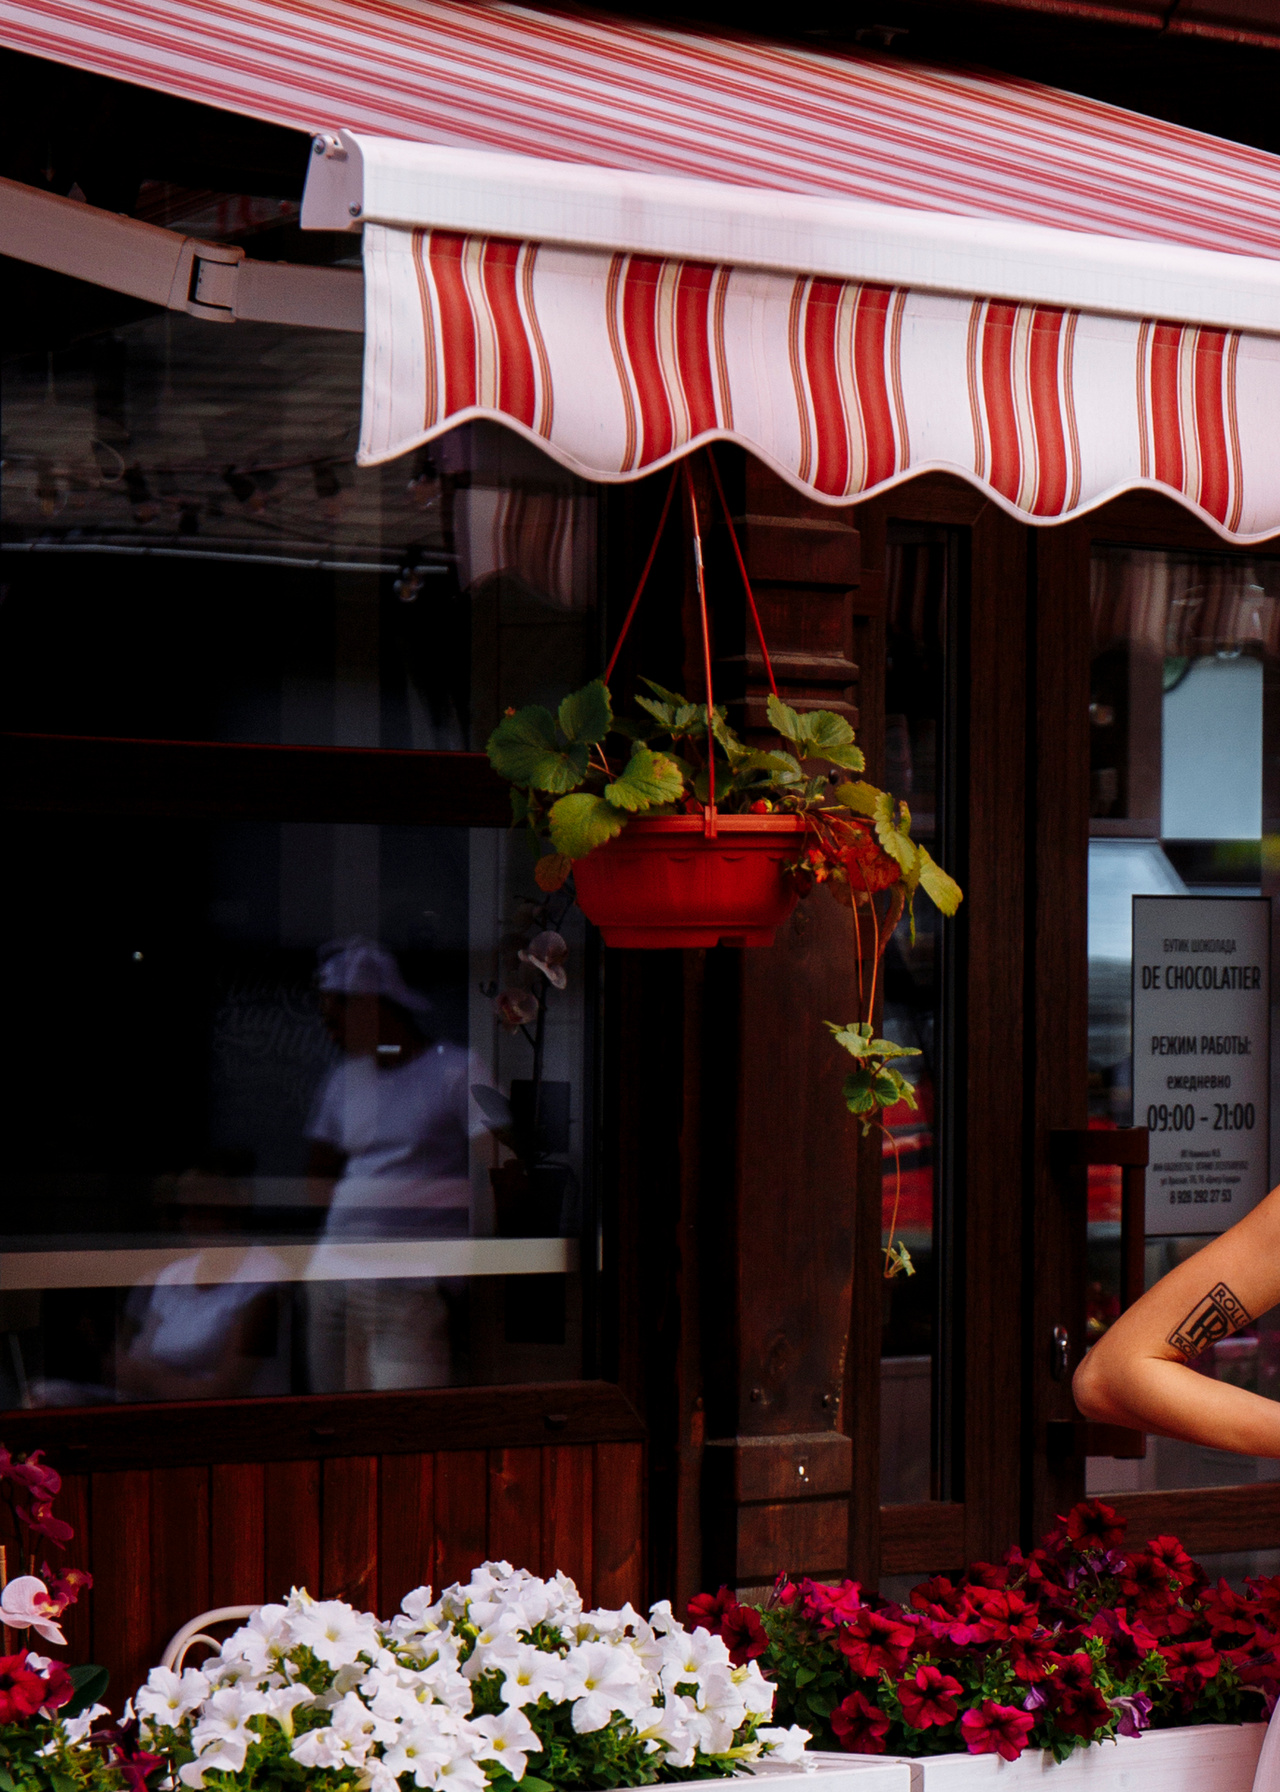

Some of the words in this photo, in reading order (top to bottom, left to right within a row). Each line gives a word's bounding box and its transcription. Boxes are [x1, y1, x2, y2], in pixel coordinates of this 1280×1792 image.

[1163, 939, 1189, 953] БУТИК
[1191, 939, 1237, 954] ШОКОЛАДА
[1142, 966, 1161, 990] DE
[1165, 966, 1261, 990] CHOCOLATIER
[1151, 1036, 1197, 1055] РЕЖИМ
[1201, 1036, 1251, 1055] РАБОТЫ:
[1166, 1075, 1231, 1092] ежедневно
[1147, 1103, 1195, 1131] 09:00
[1213, 1102, 1255, 1131] 21:00
